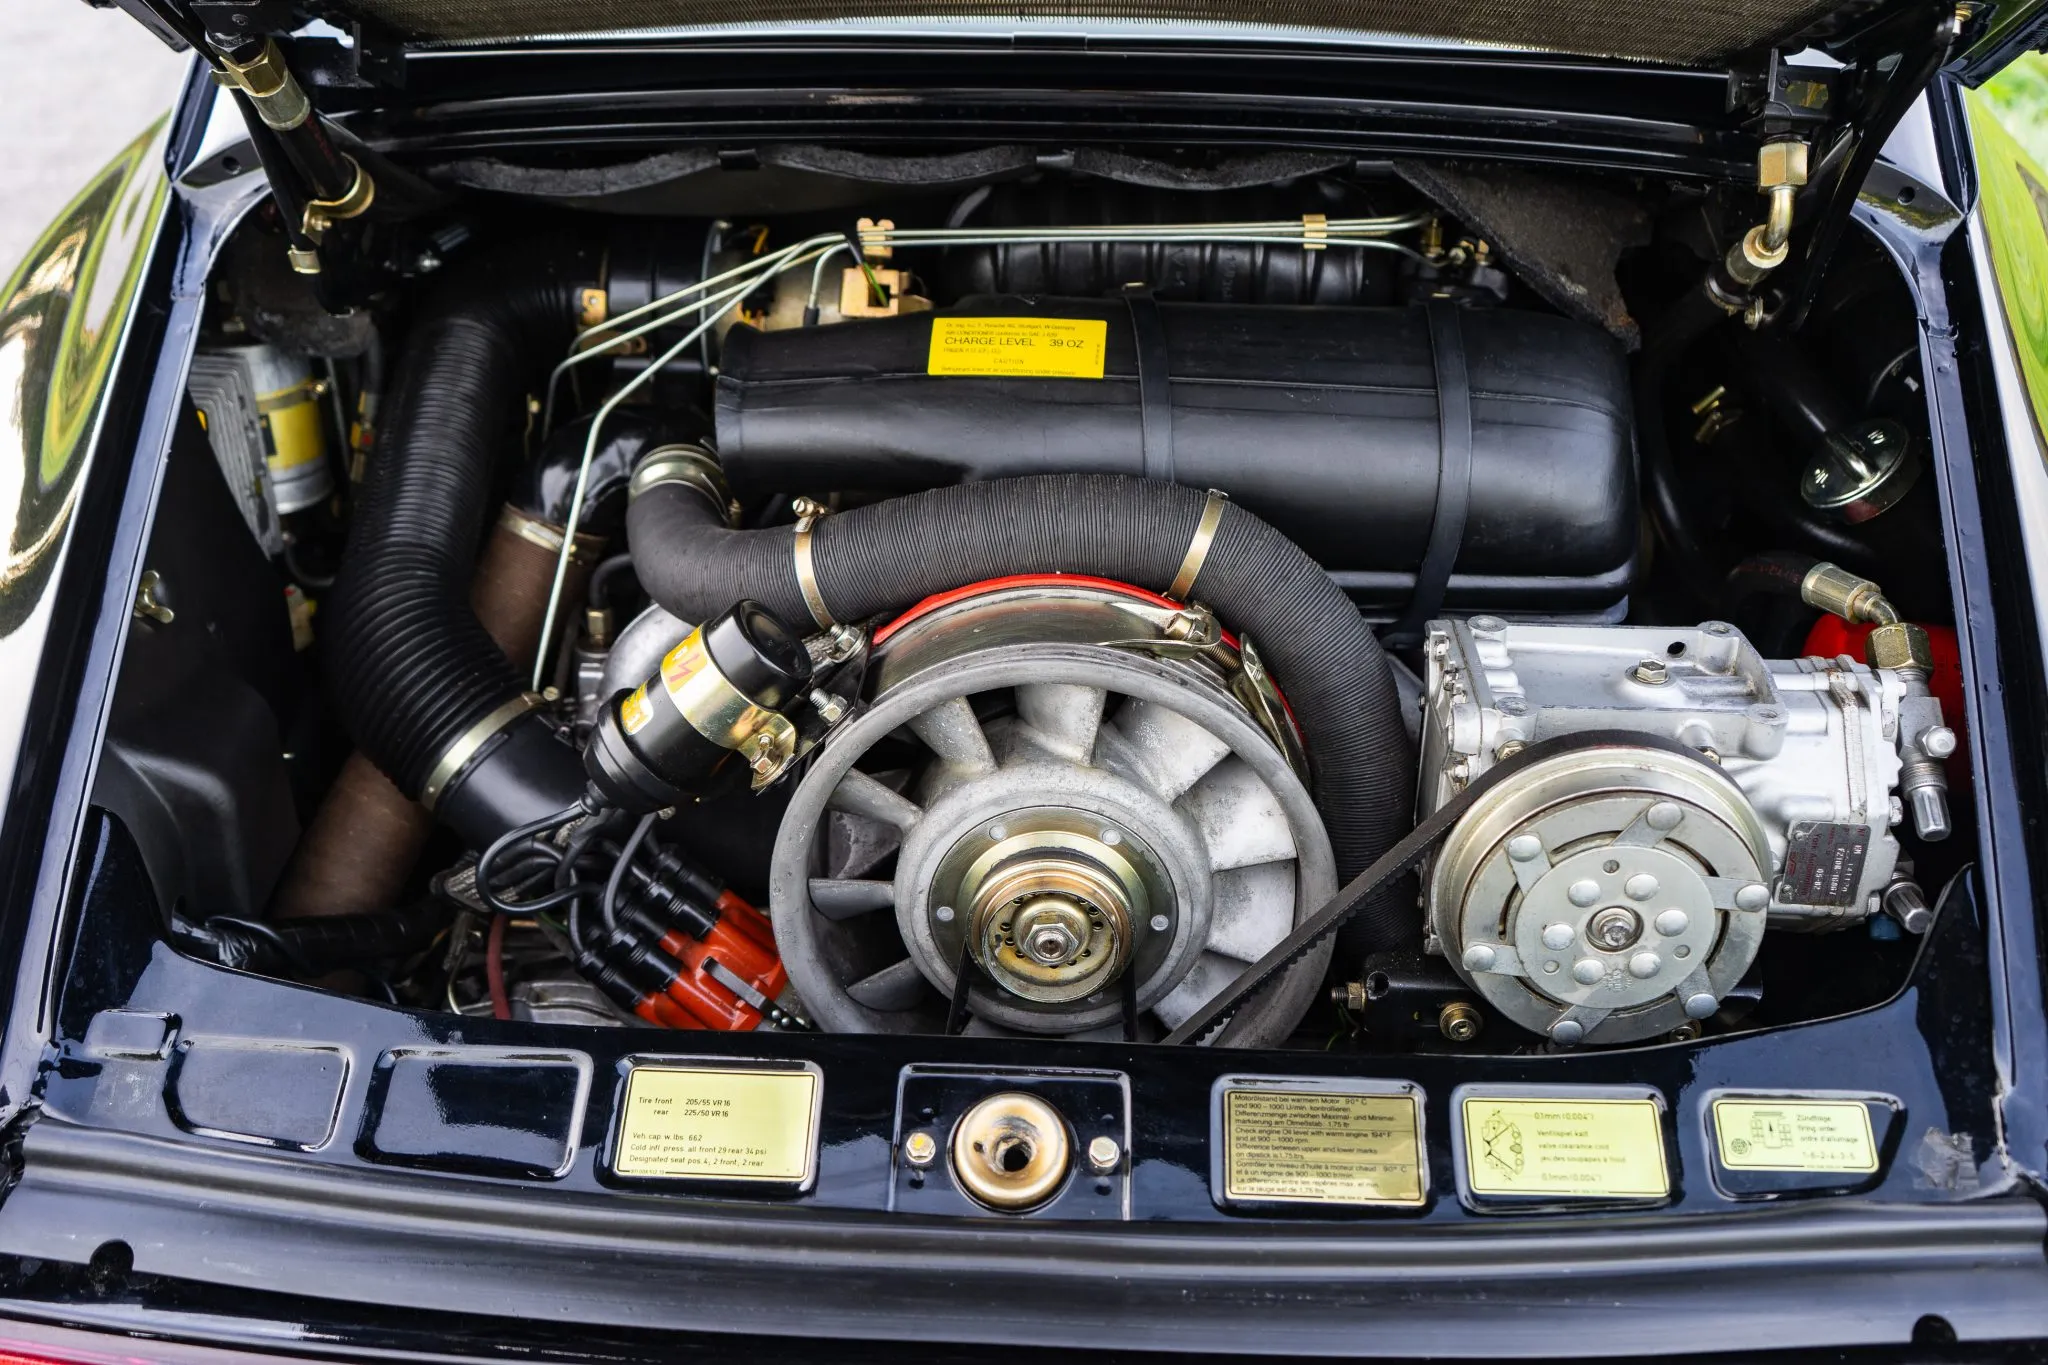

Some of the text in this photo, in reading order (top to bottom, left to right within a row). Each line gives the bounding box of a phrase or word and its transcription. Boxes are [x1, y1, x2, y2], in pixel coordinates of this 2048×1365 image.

[944, 336, 1085, 348] CHARGE LEVEL 39 OZ
[638, 1096, 653, 1104] Tire
[654, 1097, 673, 1105] front
[685, 1098, 711, 1106] 205/55
[712, 1099, 723, 1107] VR
[722, 1110, 729, 1118] 16
[1235, 1110, 1287, 1118] Differenzmenge
[1290, 1111, 1320, 1119] zwischen
[1235, 1127, 1256, 1135] Check
[688, 1134, 703, 1142] 662
[630, 1143, 647, 1151] Cold
[755, 1148, 767, 1156] psi
[629, 1154, 669, 1164] Designated
[670, 1156, 685, 1164] seat
[713, 1157, 719, 1165] 2
[1246, 1151, 1270, 1159] dipstick
